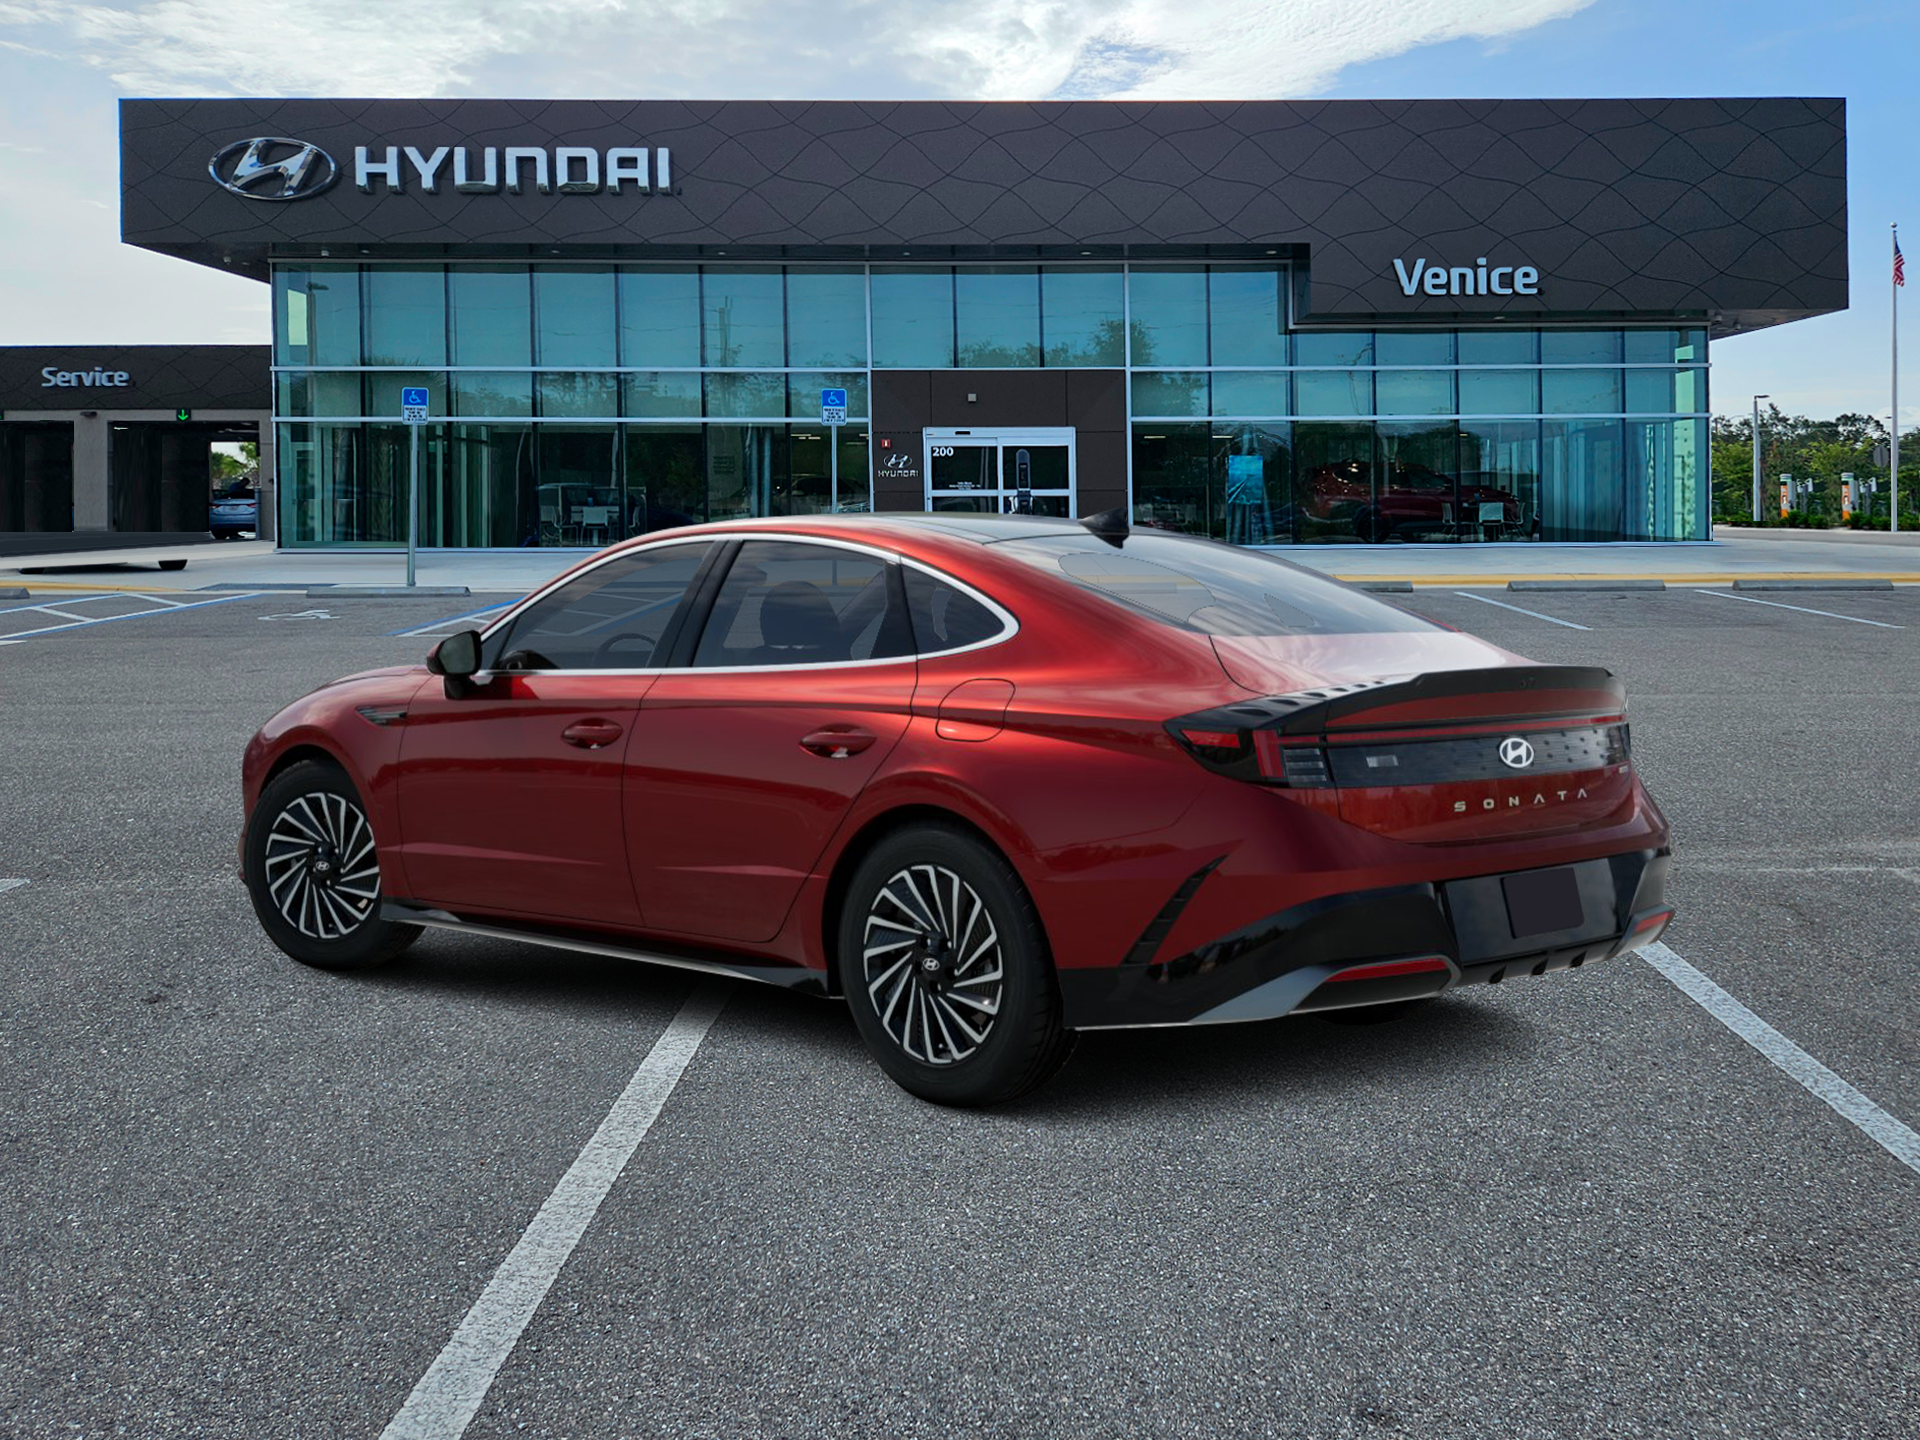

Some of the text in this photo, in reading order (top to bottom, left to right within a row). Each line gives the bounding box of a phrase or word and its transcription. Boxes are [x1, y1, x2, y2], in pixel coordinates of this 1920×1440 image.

[355, 146, 671, 193] HYUNDAI
[1393, 257, 1539, 295] Venice
[41, 366, 130, 387] Service
[932, 446, 954, 457] 200
[878, 470, 919, 478] HYUNDAI
[1454, 788, 1588, 812] SONATA
